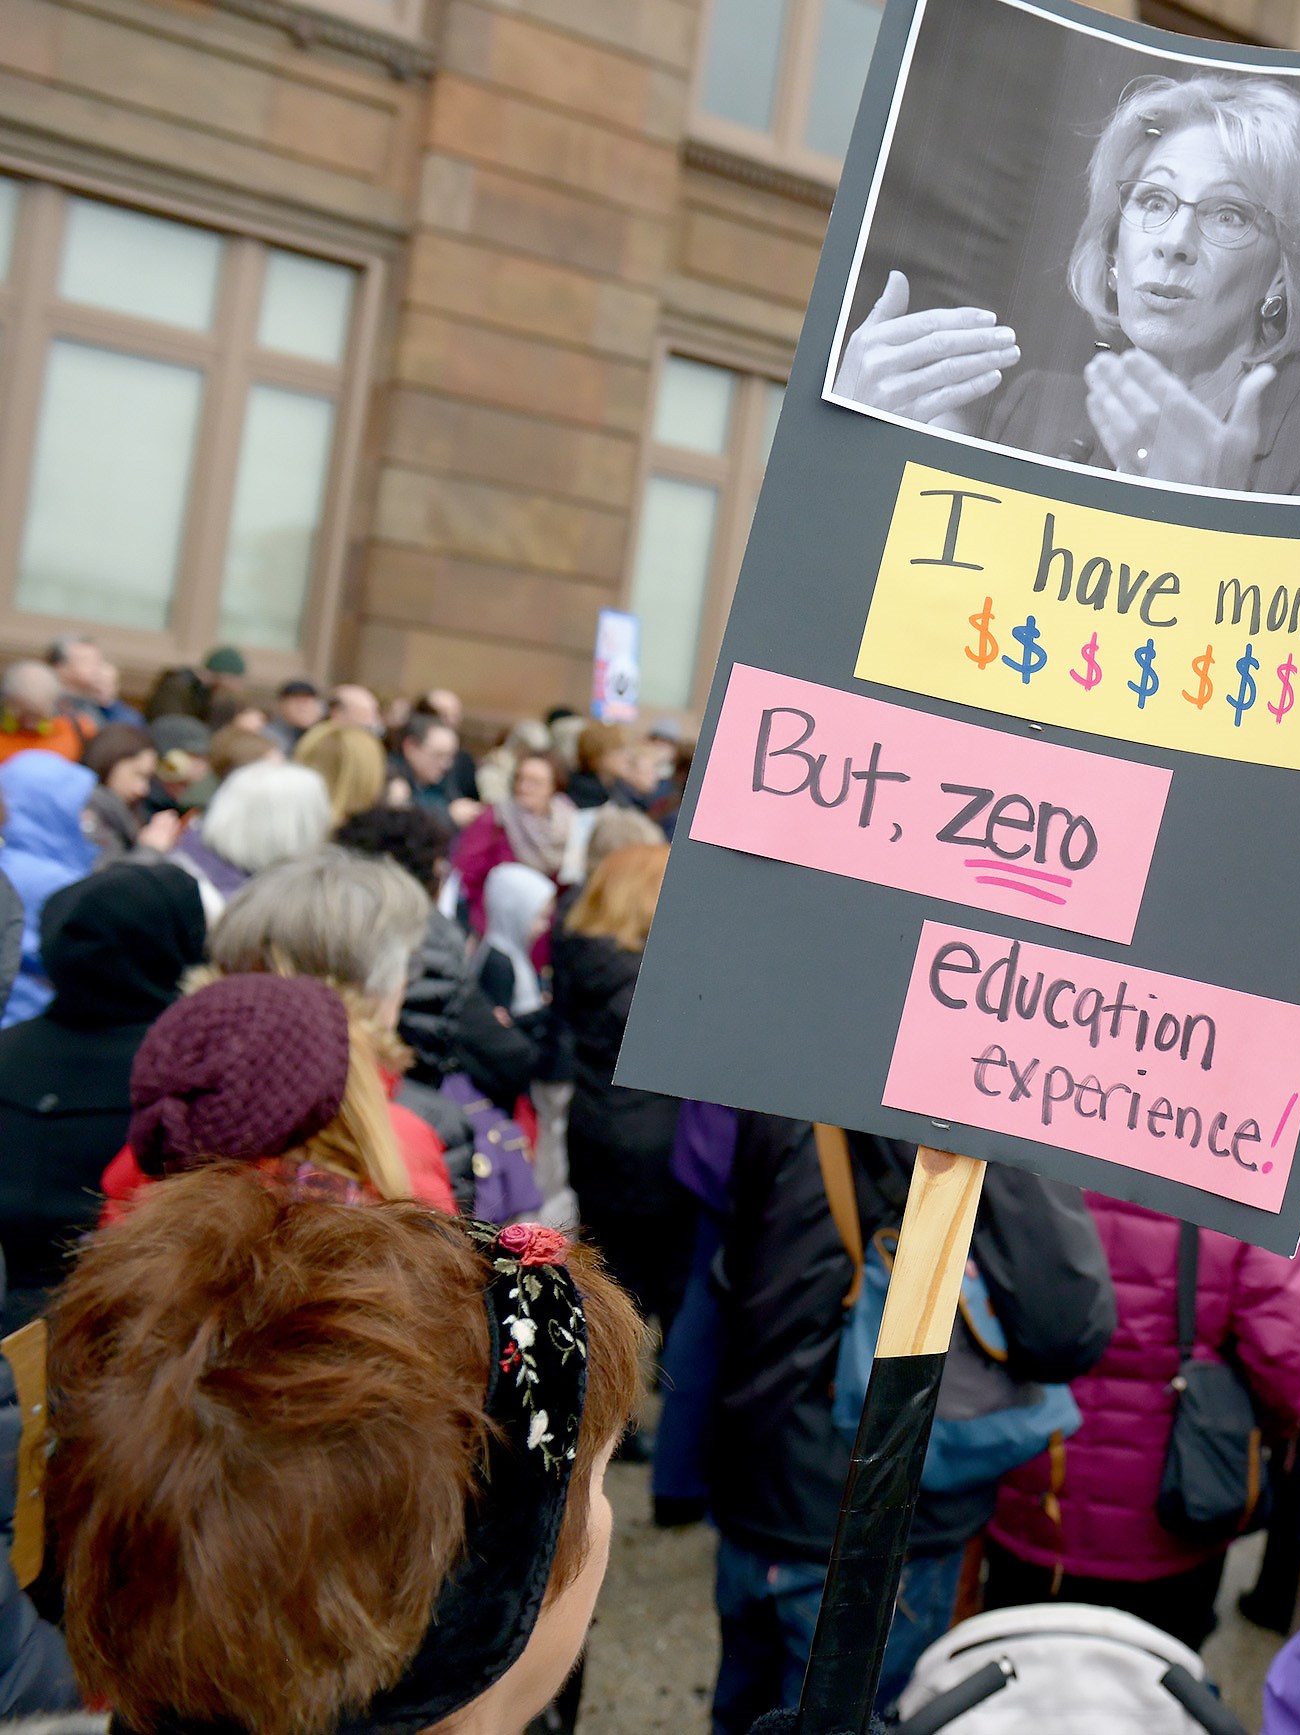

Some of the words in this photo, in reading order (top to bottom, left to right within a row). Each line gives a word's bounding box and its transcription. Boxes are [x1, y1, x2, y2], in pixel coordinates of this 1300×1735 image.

[910, 490, 1002, 570] I
[1033, 513, 1181, 628] have
[752, 708, 911, 842] But,
[936, 782, 1098, 870] zero
[929, 940, 1216, 1071] education
[971, 1044, 1299, 1174] experience!
